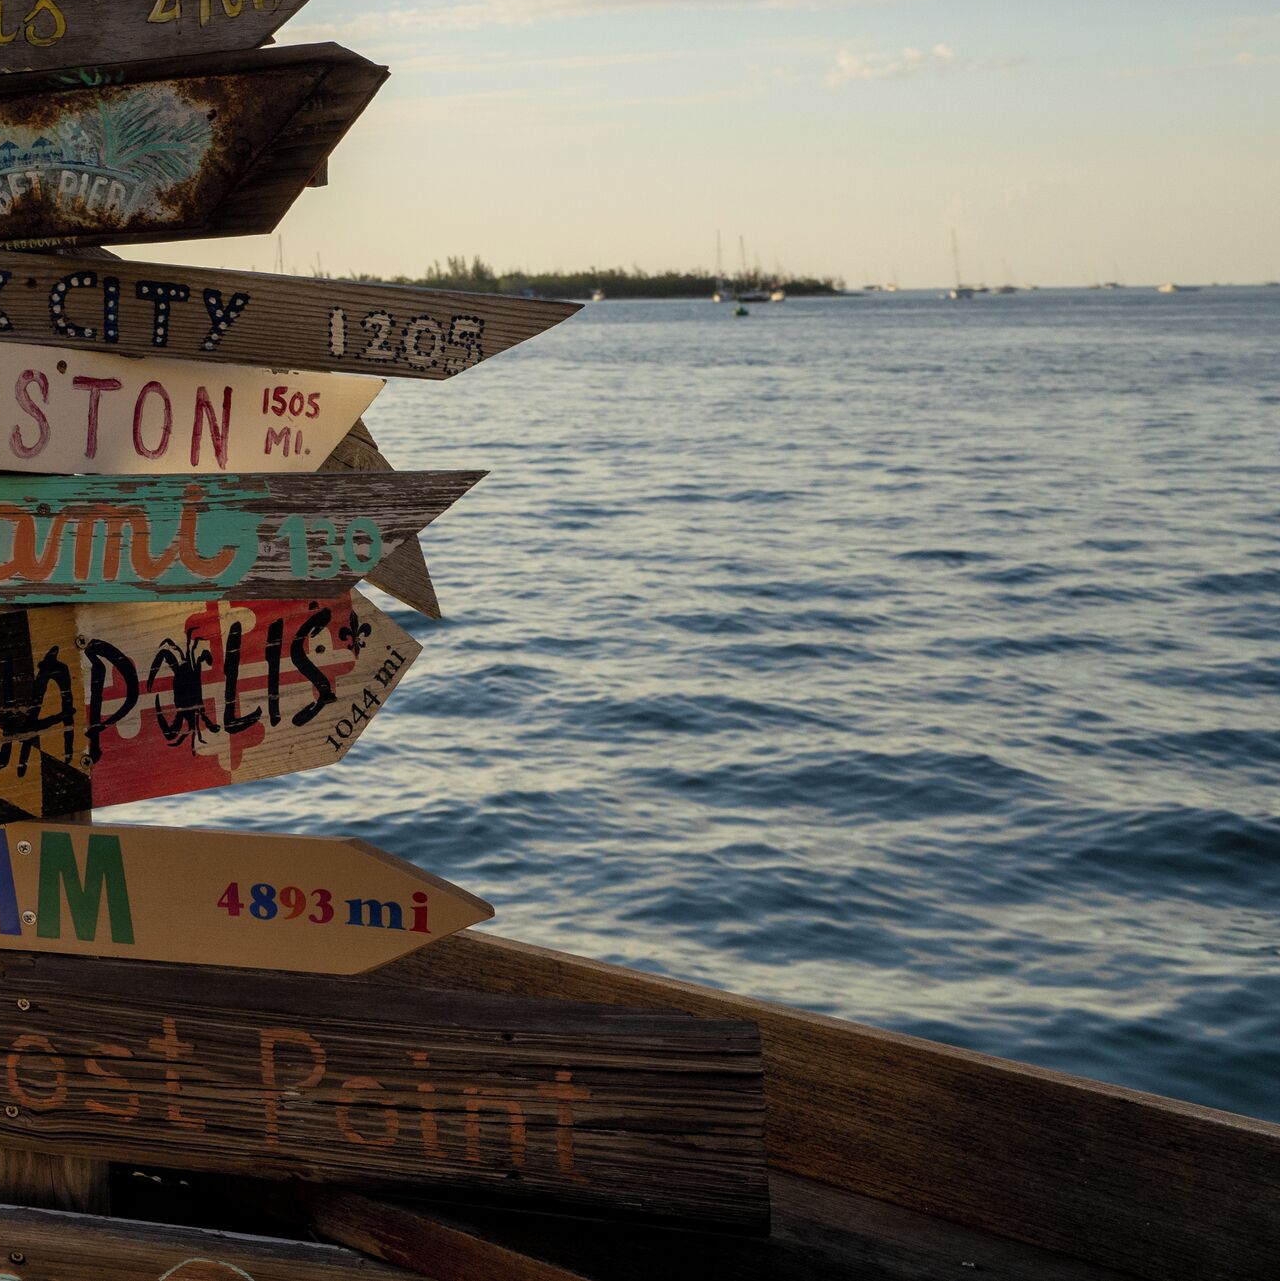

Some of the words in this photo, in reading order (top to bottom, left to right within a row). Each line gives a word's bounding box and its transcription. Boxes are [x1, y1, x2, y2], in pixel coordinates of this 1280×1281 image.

[47, 270, 252, 352] CITY
[262, 386, 321, 419] 1505
[264, 425, 311, 457] MI.
[275, 514, 384, 580] 130
[325, 687, 381, 753] 1044
[373, 645, 407, 689] mi
[217, 881, 335, 924] 4893
[345, 890, 432, 934] mi
[259, 1028, 595, 1186] Point
